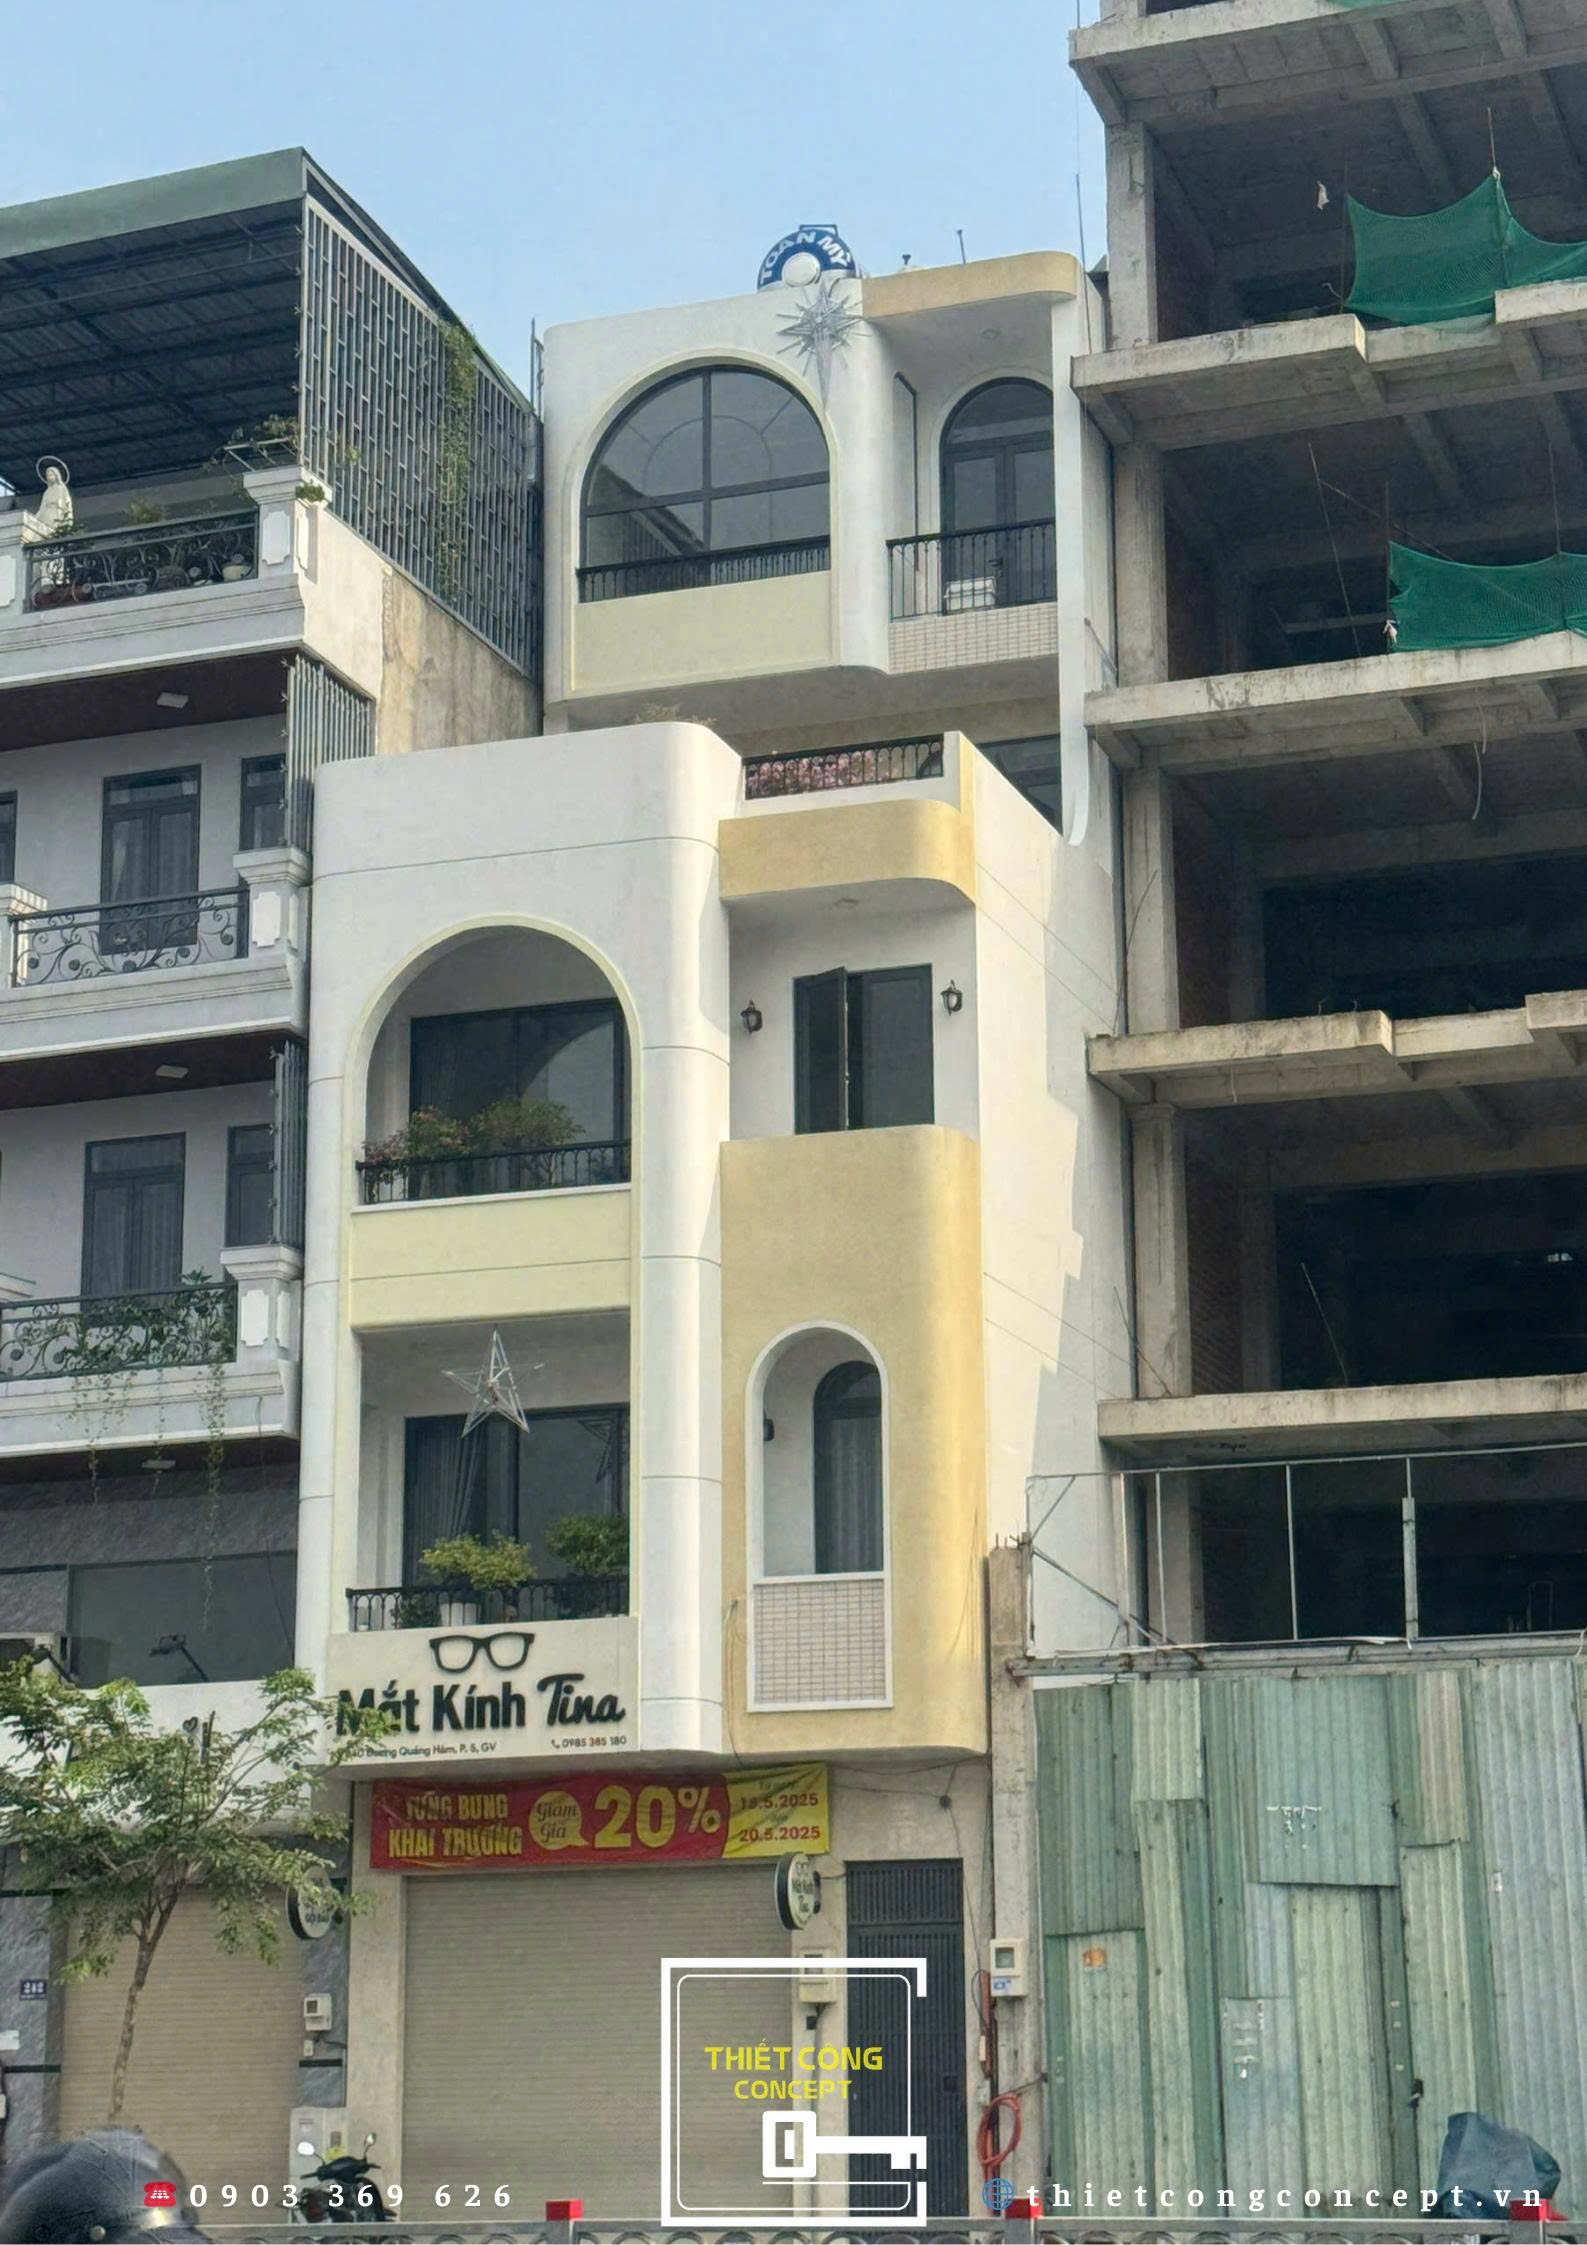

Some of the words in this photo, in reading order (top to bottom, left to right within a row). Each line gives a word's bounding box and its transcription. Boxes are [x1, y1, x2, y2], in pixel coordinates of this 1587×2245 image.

[336, 1679, 420, 1736] Mắt
[432, 1681, 526, 1731] Kính
[537, 1673, 626, 1726] Tina
[481, 1742, 497, 1752] GV
[594, 1785, 720, 1849] 20%
[388, 1827, 435, 1858] KHAI
[740, 1826, 821, 1842] 20.5.2025
